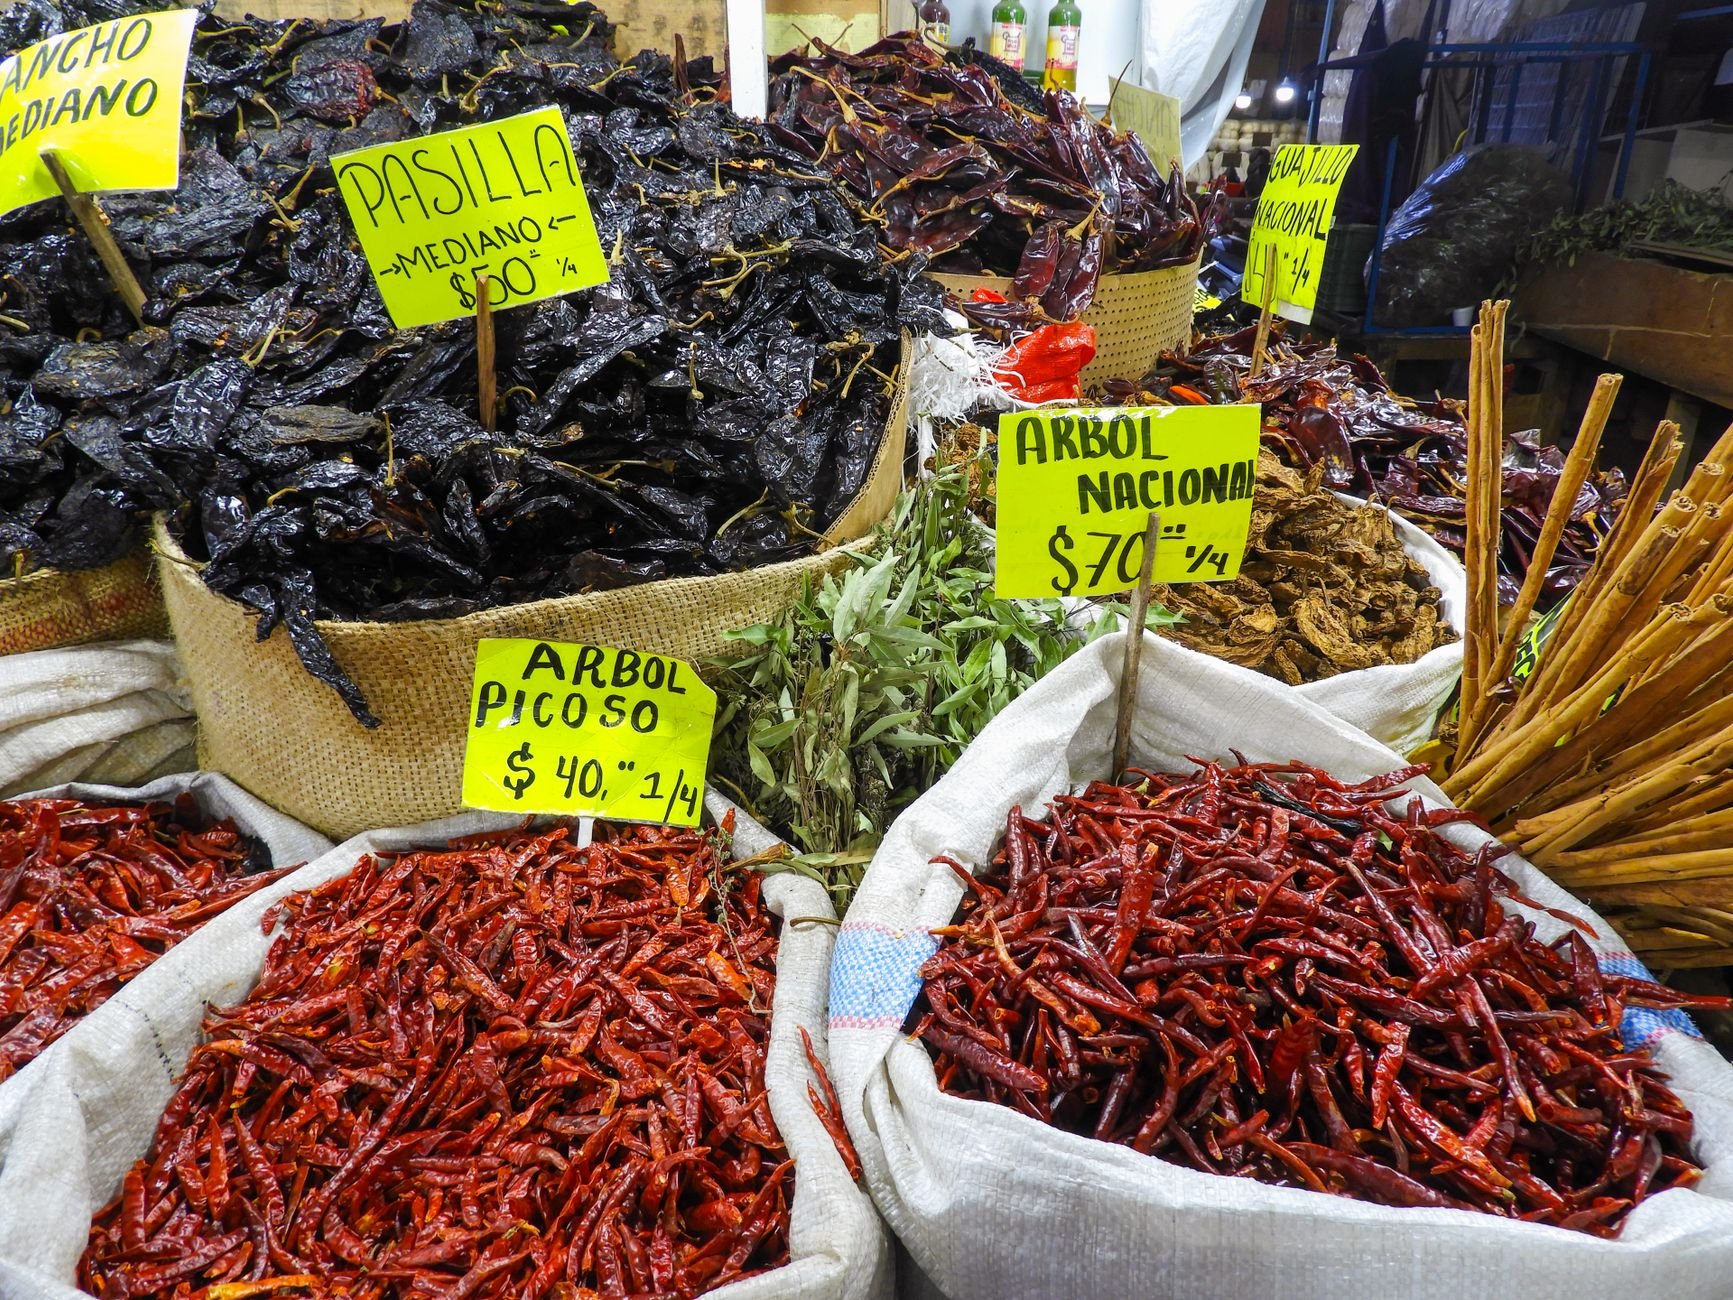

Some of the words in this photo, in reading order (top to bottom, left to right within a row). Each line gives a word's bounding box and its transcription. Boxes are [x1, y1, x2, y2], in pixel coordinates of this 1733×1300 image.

[0, 18, 152, 100] ANCHO
[338, 124, 576, 228] PASILLA
[1269, 146, 1353, 188] GUAJILLO
[1255, 198, 1328, 241] NACIONAL
[396, 216, 542, 279] MEDIANO
[556, 256, 578, 277] 1/4
[1291, 247, 1310, 296] 1/4
[1016, 414, 1168, 465] ARBOL
[1077, 459, 1254, 514] NACIONAL
[1184, 544, 1229, 575] 1/4
[521, 642, 686, 695] ARBOL
[474, 681, 659, 733] PICOSO
[640, 769, 698, 823] 1/4
